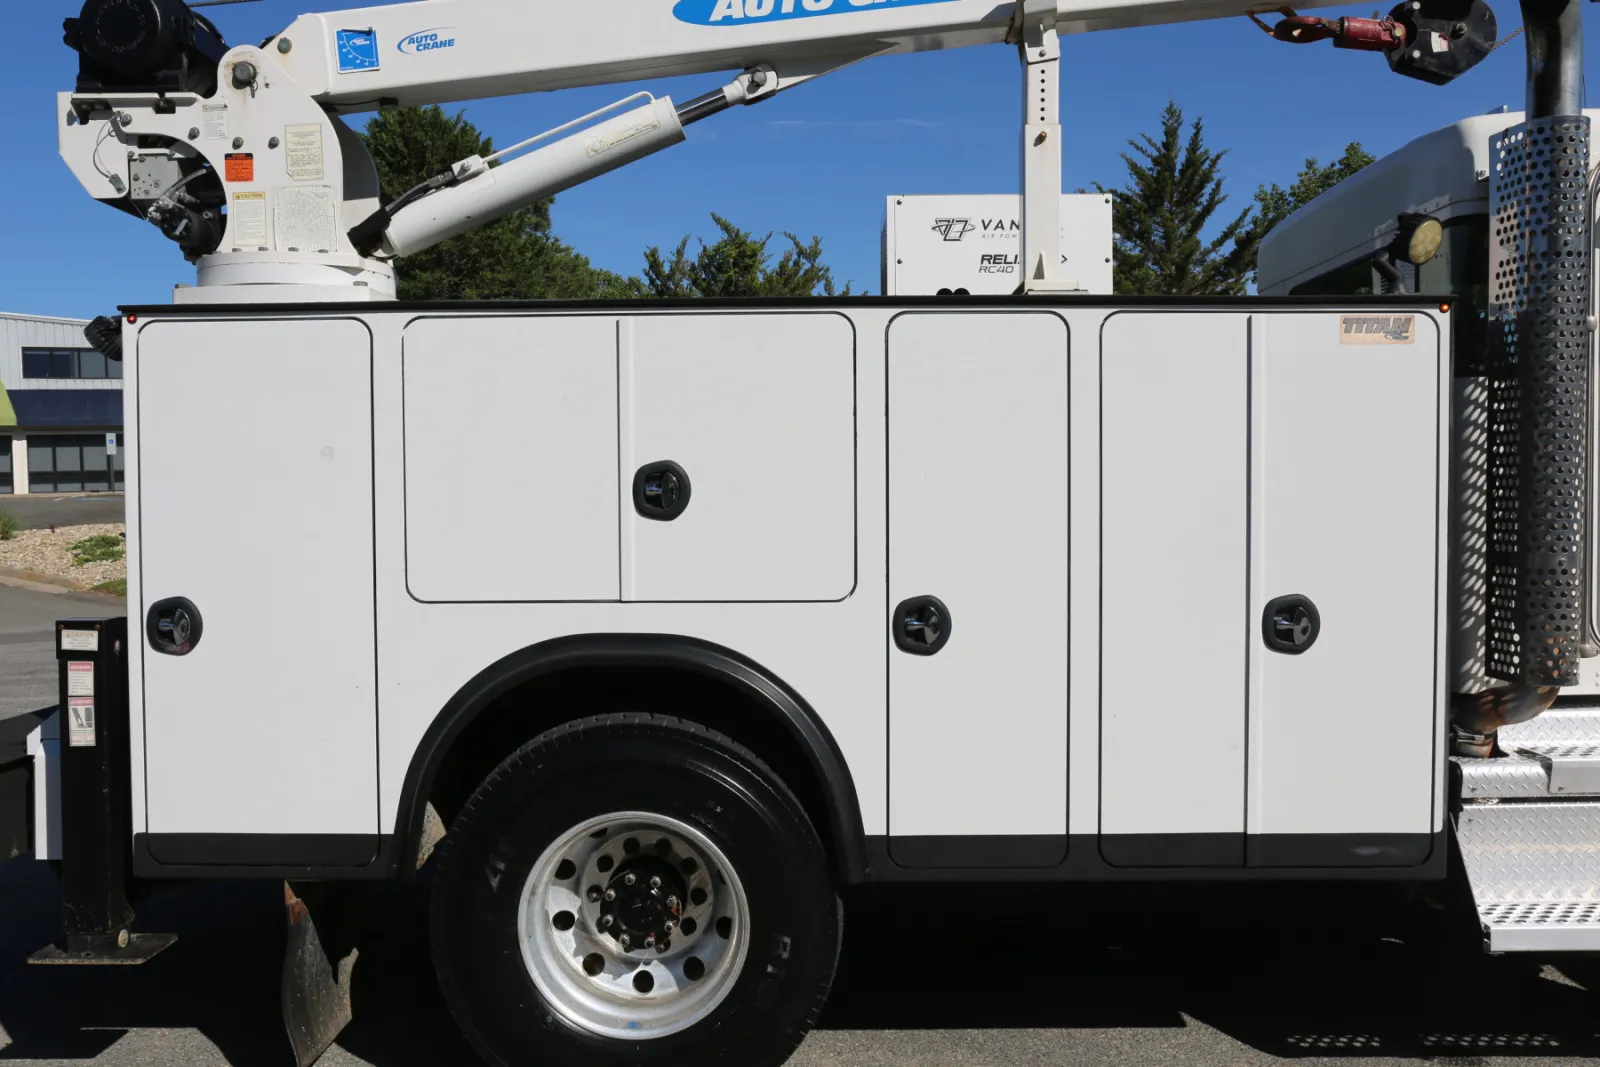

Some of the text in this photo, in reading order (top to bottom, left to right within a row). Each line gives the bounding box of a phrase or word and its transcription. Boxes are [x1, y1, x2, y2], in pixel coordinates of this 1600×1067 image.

[407, 33, 438, 45] AUTO
[416, 38, 455, 52] CRANE
[981, 219, 1020, 231] VAN
[981, 254, 1020, 264] RELI
[1342, 318, 1412, 334] TITAN
